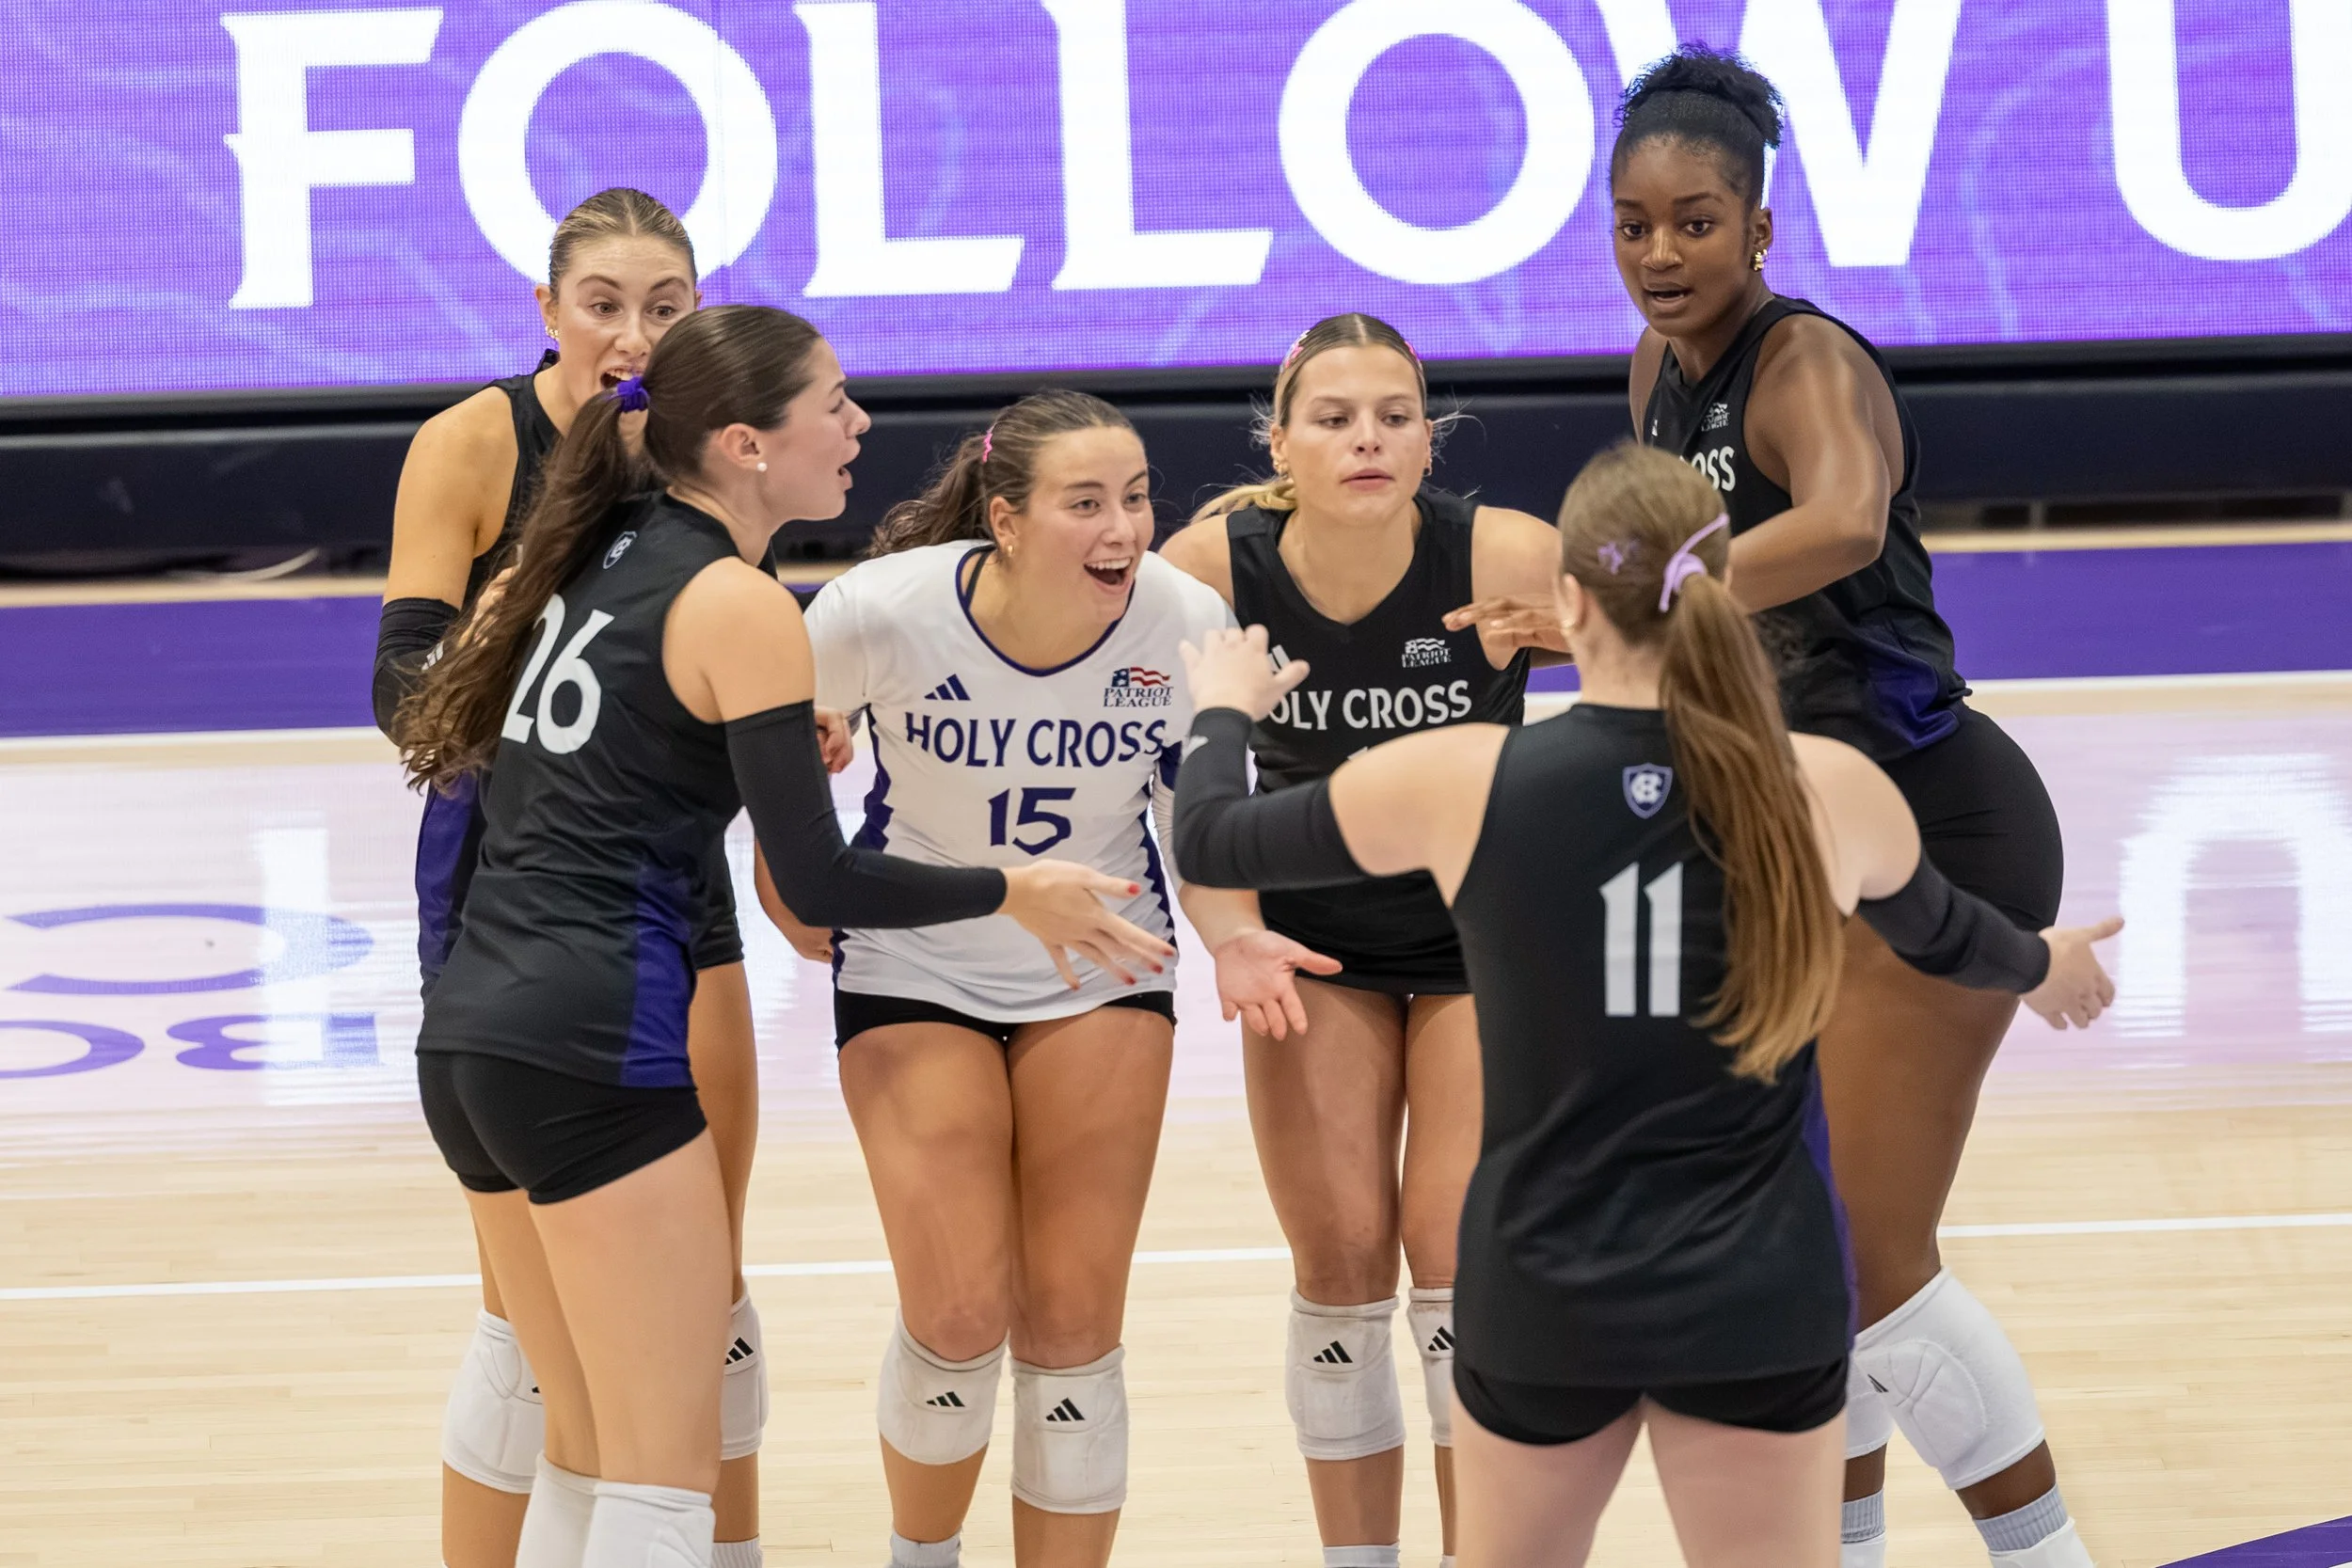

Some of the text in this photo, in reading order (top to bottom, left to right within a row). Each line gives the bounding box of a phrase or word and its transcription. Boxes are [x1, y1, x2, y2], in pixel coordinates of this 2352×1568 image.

[219, 0, 1962, 309] FOLLOW
[501, 593, 615, 754] 26
[1103, 686, 1175, 698] PATRIOT
[1103, 696, 1172, 707] LEAGUE
[1268, 679, 1472, 731] OLY CROSS
[905, 711, 1168, 768] HOLY CROSS
[988, 786, 1077, 856] 15
[1598, 861, 1684, 1018] 11
